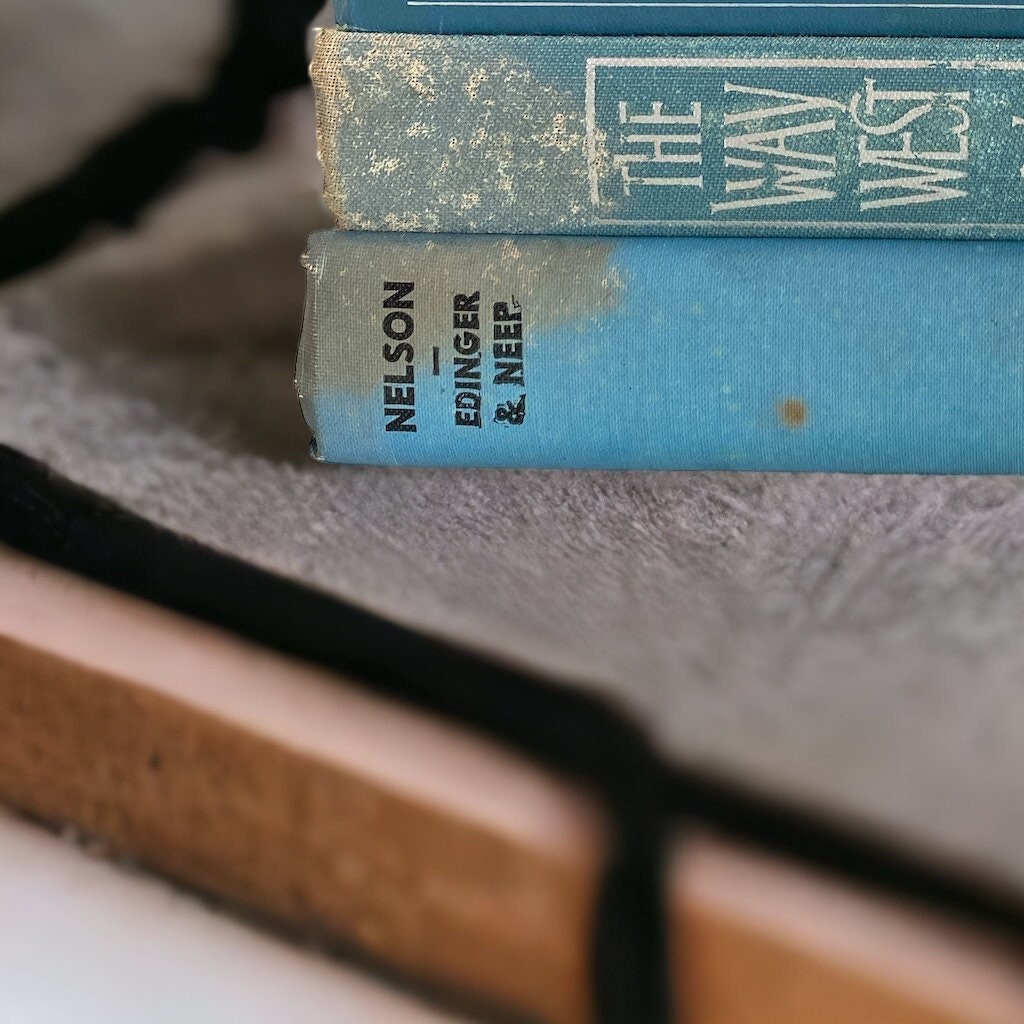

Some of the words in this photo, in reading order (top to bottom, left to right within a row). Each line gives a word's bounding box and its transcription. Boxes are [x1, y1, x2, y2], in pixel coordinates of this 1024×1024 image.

[613, 100, 704, 197] THE
[709, 80, 851, 215] WAY
[849, 76, 971, 212] WEST
[382, 281, 418, 433] NELSON
[453, 290, 483, 429] EDINGER
[492, 393, 527, 427] &
